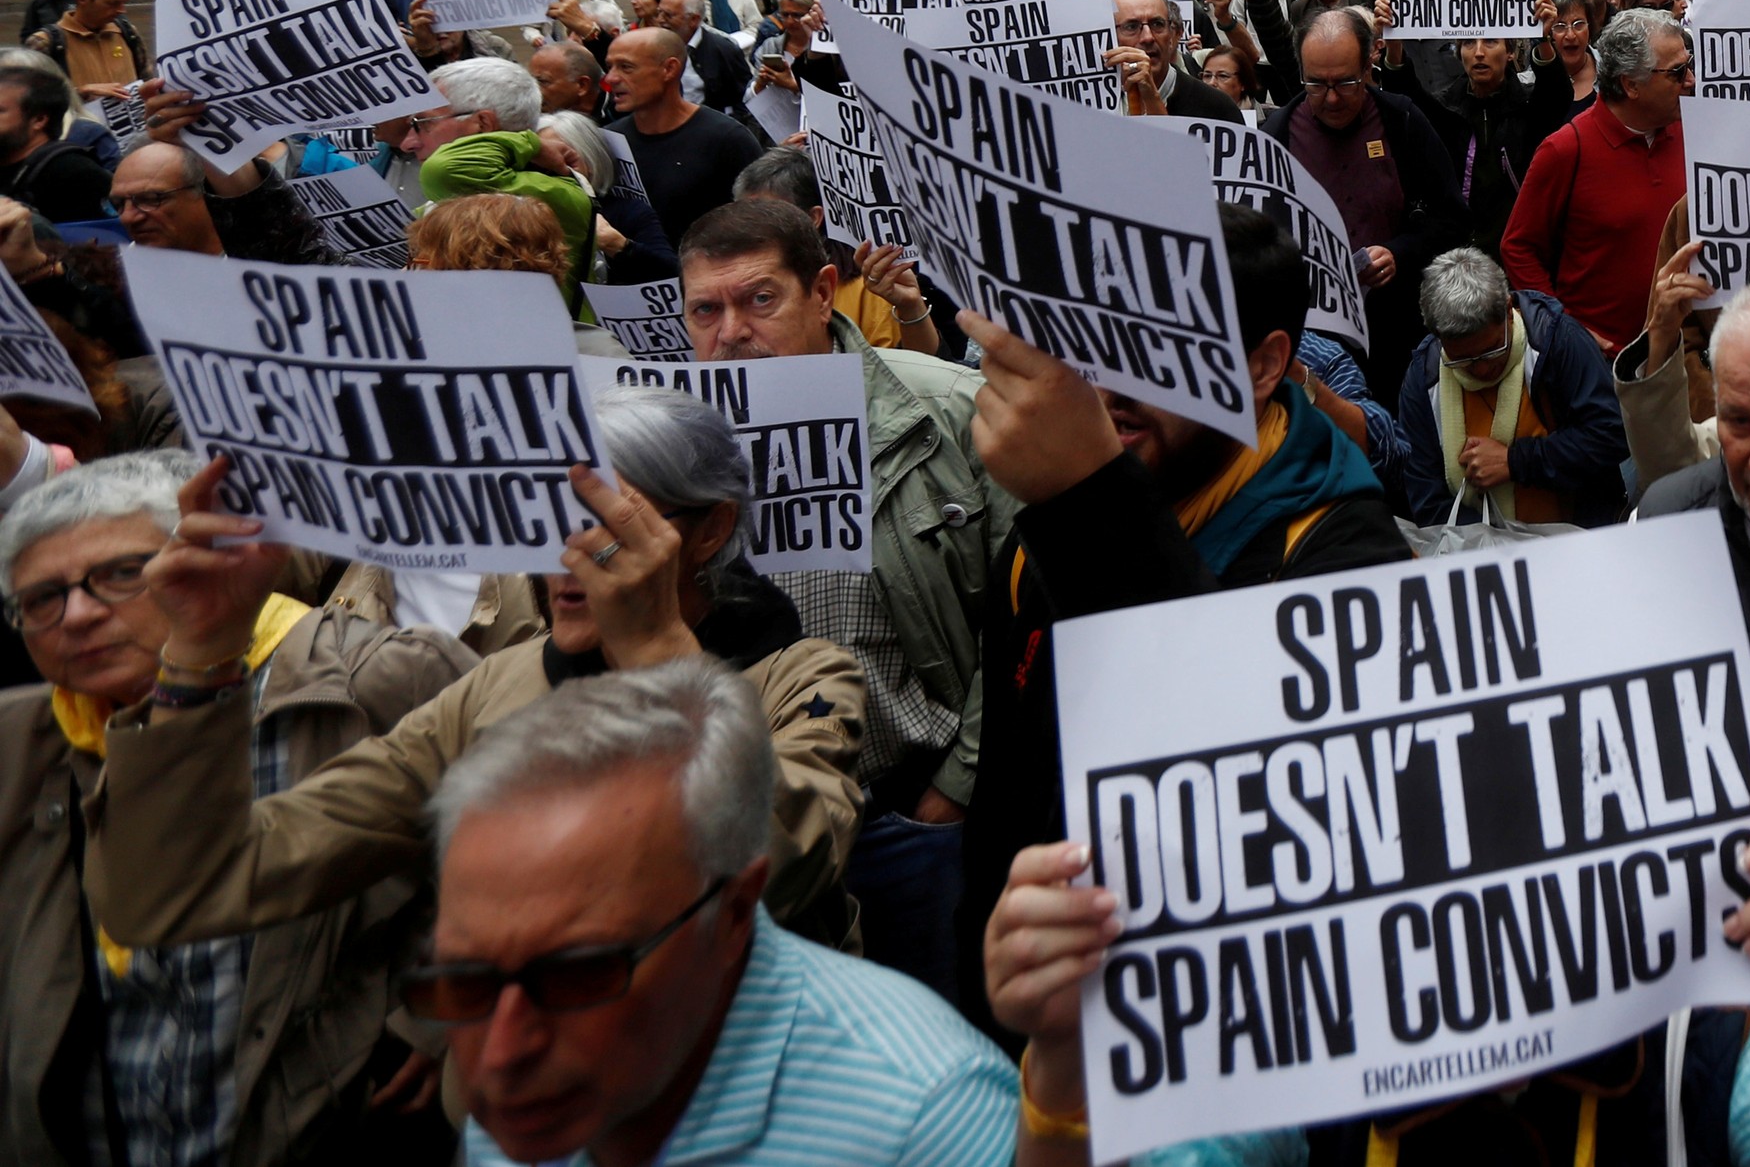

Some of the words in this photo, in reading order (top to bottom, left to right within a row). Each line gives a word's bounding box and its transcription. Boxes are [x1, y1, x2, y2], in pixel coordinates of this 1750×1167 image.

[966, 0, 1050, 44] SPAIN
[1391, 0, 1442, 28] SPAIN
[270, 53, 430, 123] CONVICTS
[951, 44, 1030, 81] SN'T
[1040, 31, 1109, 78] TALK
[903, 47, 1063, 194] SPAIN
[1033, 74, 1118, 111] VICTS
[292, 178, 351, 214] PAIN
[813, 134, 901, 204] DOESN'T
[351, 201, 410, 243] TALK
[824, 185, 866, 242] SPAIN
[867, 105, 1020, 283] DOESN'T
[1040, 200, 1225, 333] TALK
[1284, 196, 1356, 297] TALK
[243, 270, 426, 360] SPAIN
[605, 317, 693, 353] DOESN
[978, 274, 1244, 415] CONVICTS
[182, 348, 394, 461] DOESN'T
[404, 371, 594, 464] TALK
[206, 441, 349, 533] SPAIN
[346, 469, 594, 546] CONVICT
[735, 423, 859, 497] TALK
[751, 492, 863, 555] VICTS
[1275, 559, 1542, 722] SPAIN
[1096, 711, 1473, 931] DOESN'T
[1104, 917, 1357, 1096] SPAIN
[1363, 1030, 1555, 1097] ENCARTELLEM.CAT
